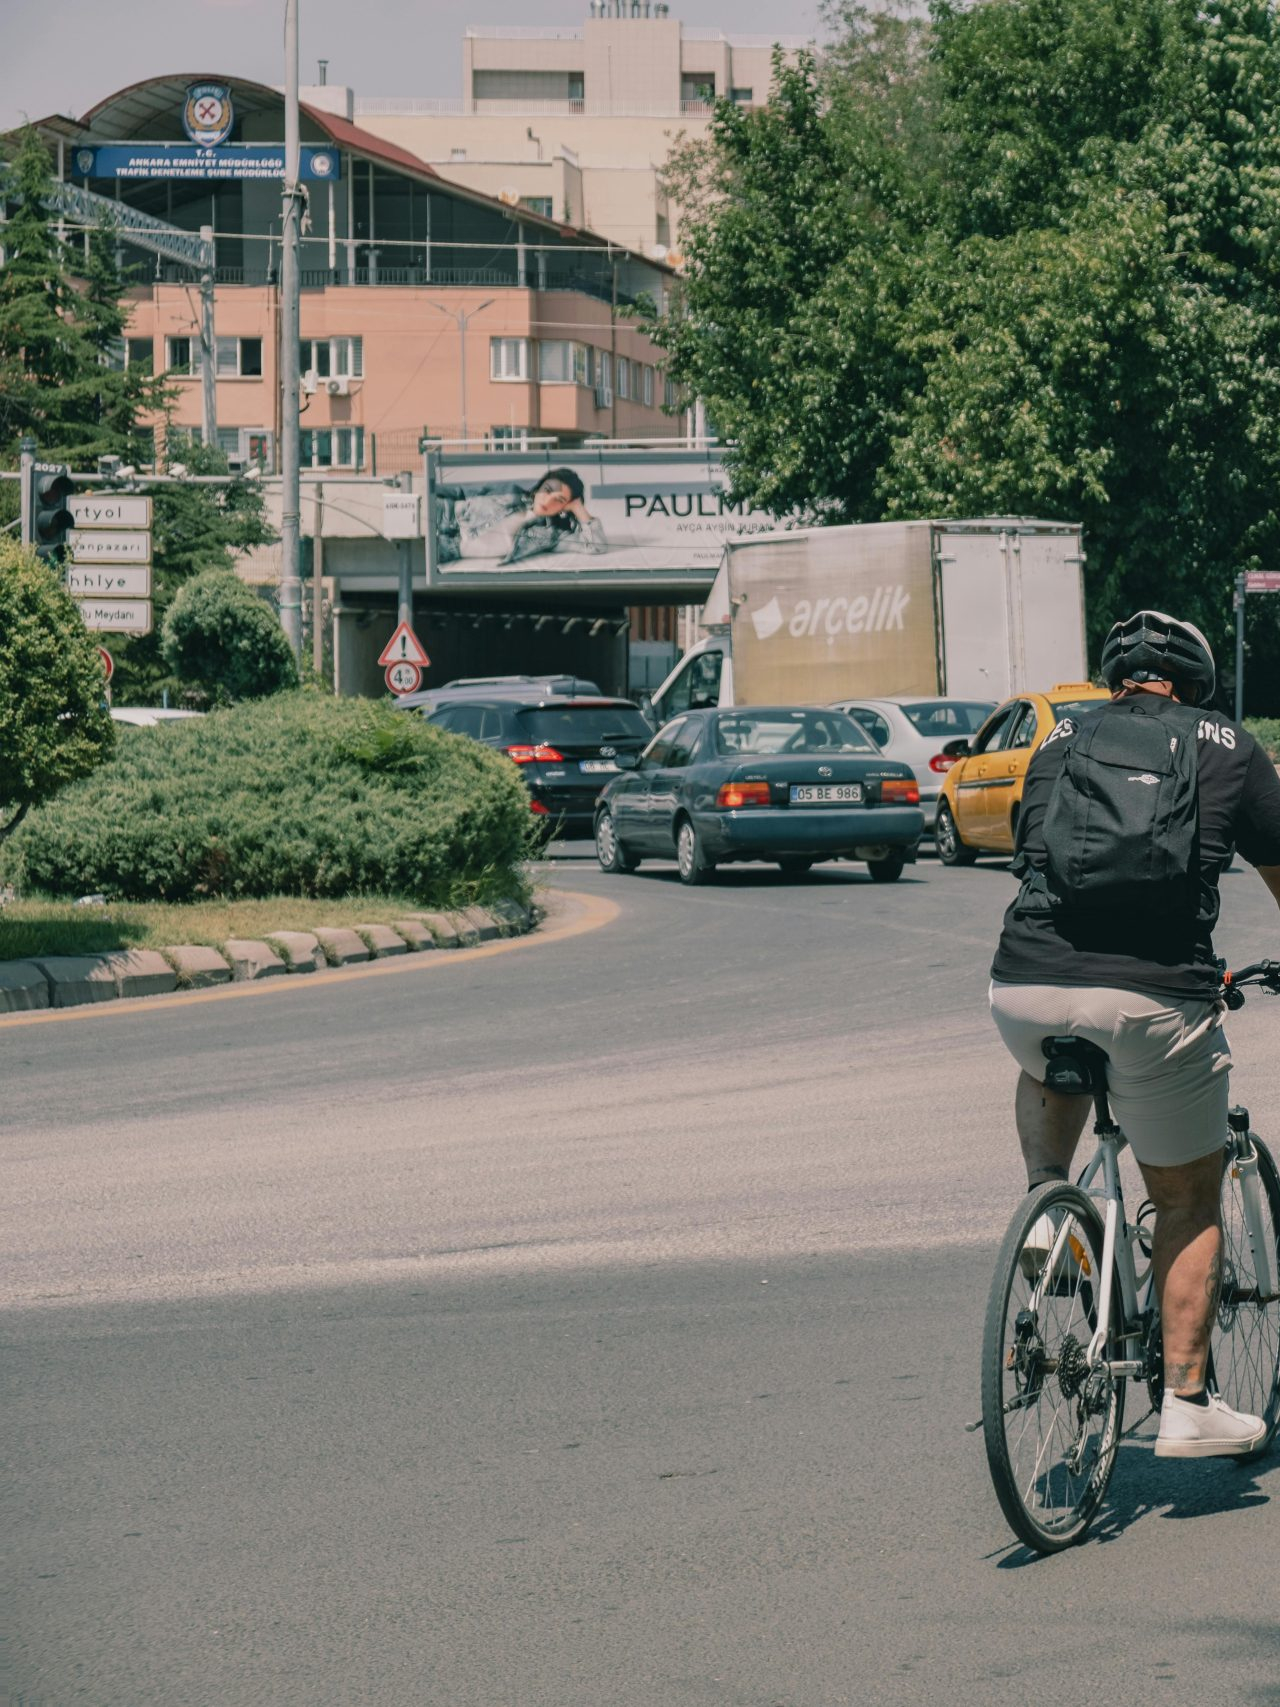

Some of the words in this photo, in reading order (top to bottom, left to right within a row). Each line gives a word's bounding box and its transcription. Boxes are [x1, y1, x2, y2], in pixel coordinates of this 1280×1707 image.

[128, 158, 171, 167] ANKARA
[173, 157, 217, 167] EMNİYET
[116, 166, 149, 176] TRAFİK
[151, 168, 205, 177] DENETLEME
[233, 166, 286, 178] MÜDÜRLÜĞ
[34, 463, 63, 473] 2027
[75, 506, 121, 520] rtyol
[676, 523, 702, 533] AYÇA
[95, 608, 134, 621] Meydanı
[788, 584, 911, 646] arçelik
[394, 669, 403, 685] 4
[797, 788, 813, 800] 05
[816, 788, 832, 800] BE
[836, 787, 859, 799] 986
